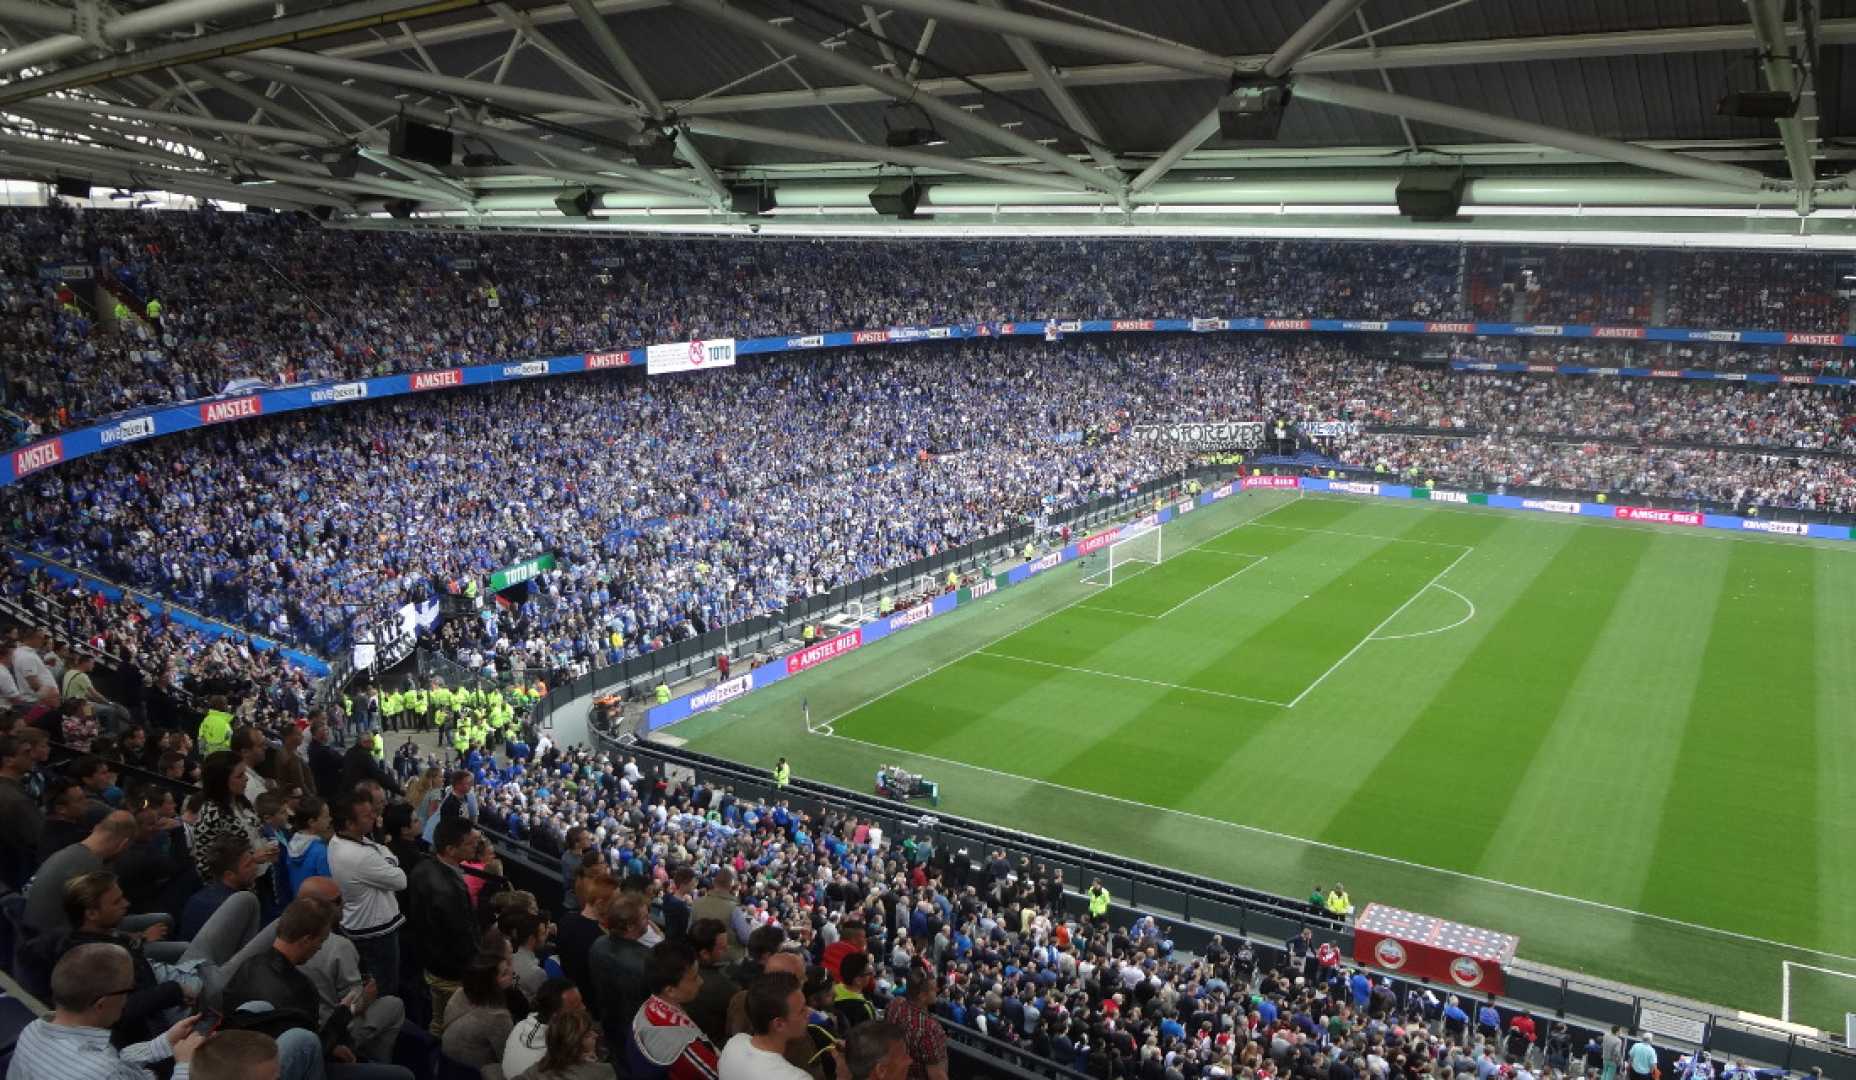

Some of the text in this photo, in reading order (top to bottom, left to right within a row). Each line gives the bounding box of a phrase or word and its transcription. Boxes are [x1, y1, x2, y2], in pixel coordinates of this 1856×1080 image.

[1790, 335, 1837, 345] AMSTEL
[590, 353, 626, 368] AMSTEL
[708, 345, 731, 361] TOTO
[415, 369, 458, 389] AMSTEL
[207, 397, 257, 421] AMSTEL
[18, 443, 60, 475] AMSTEL
[1630, 509, 1671, 521] AMSTEL
[800, 633, 858, 666] AMSTEL BIER
